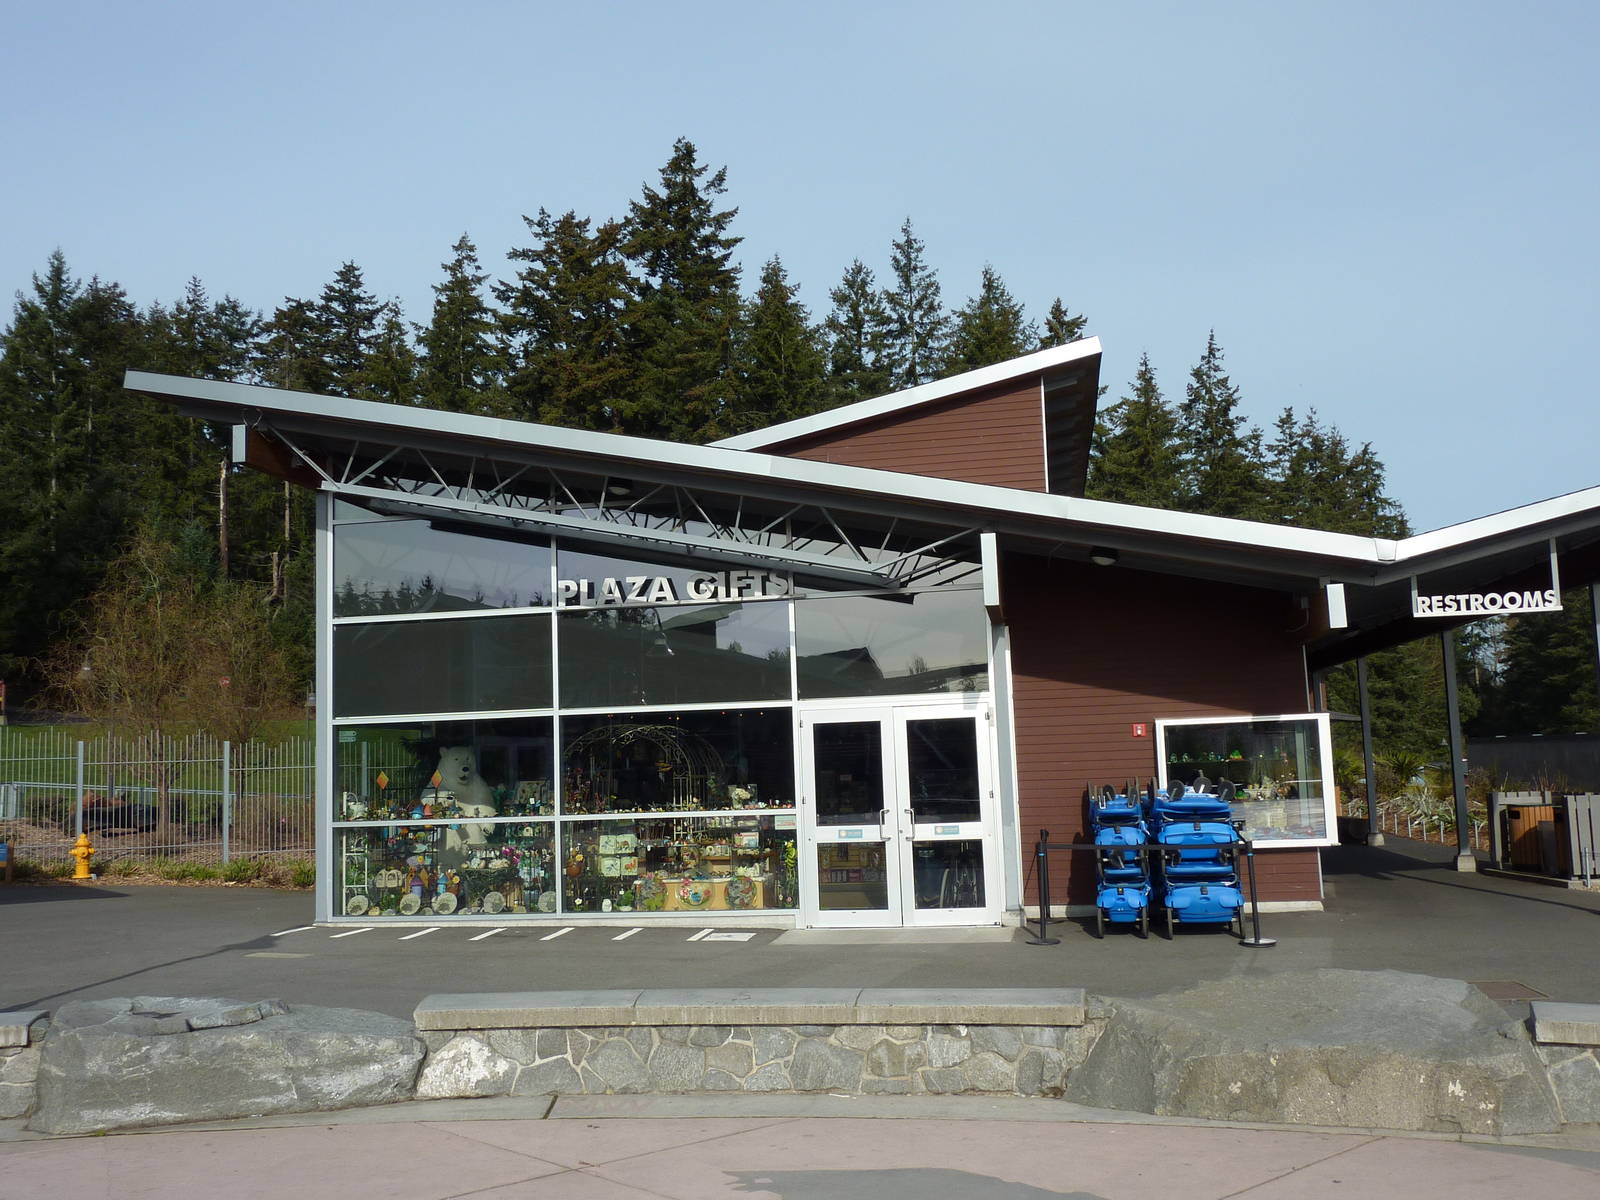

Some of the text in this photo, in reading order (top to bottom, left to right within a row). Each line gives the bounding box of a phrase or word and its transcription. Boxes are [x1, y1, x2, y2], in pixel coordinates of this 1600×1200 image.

[558, 570, 788, 607] PLAZA GIFTS
[1417, 590, 1556, 614] RESTROOMS
